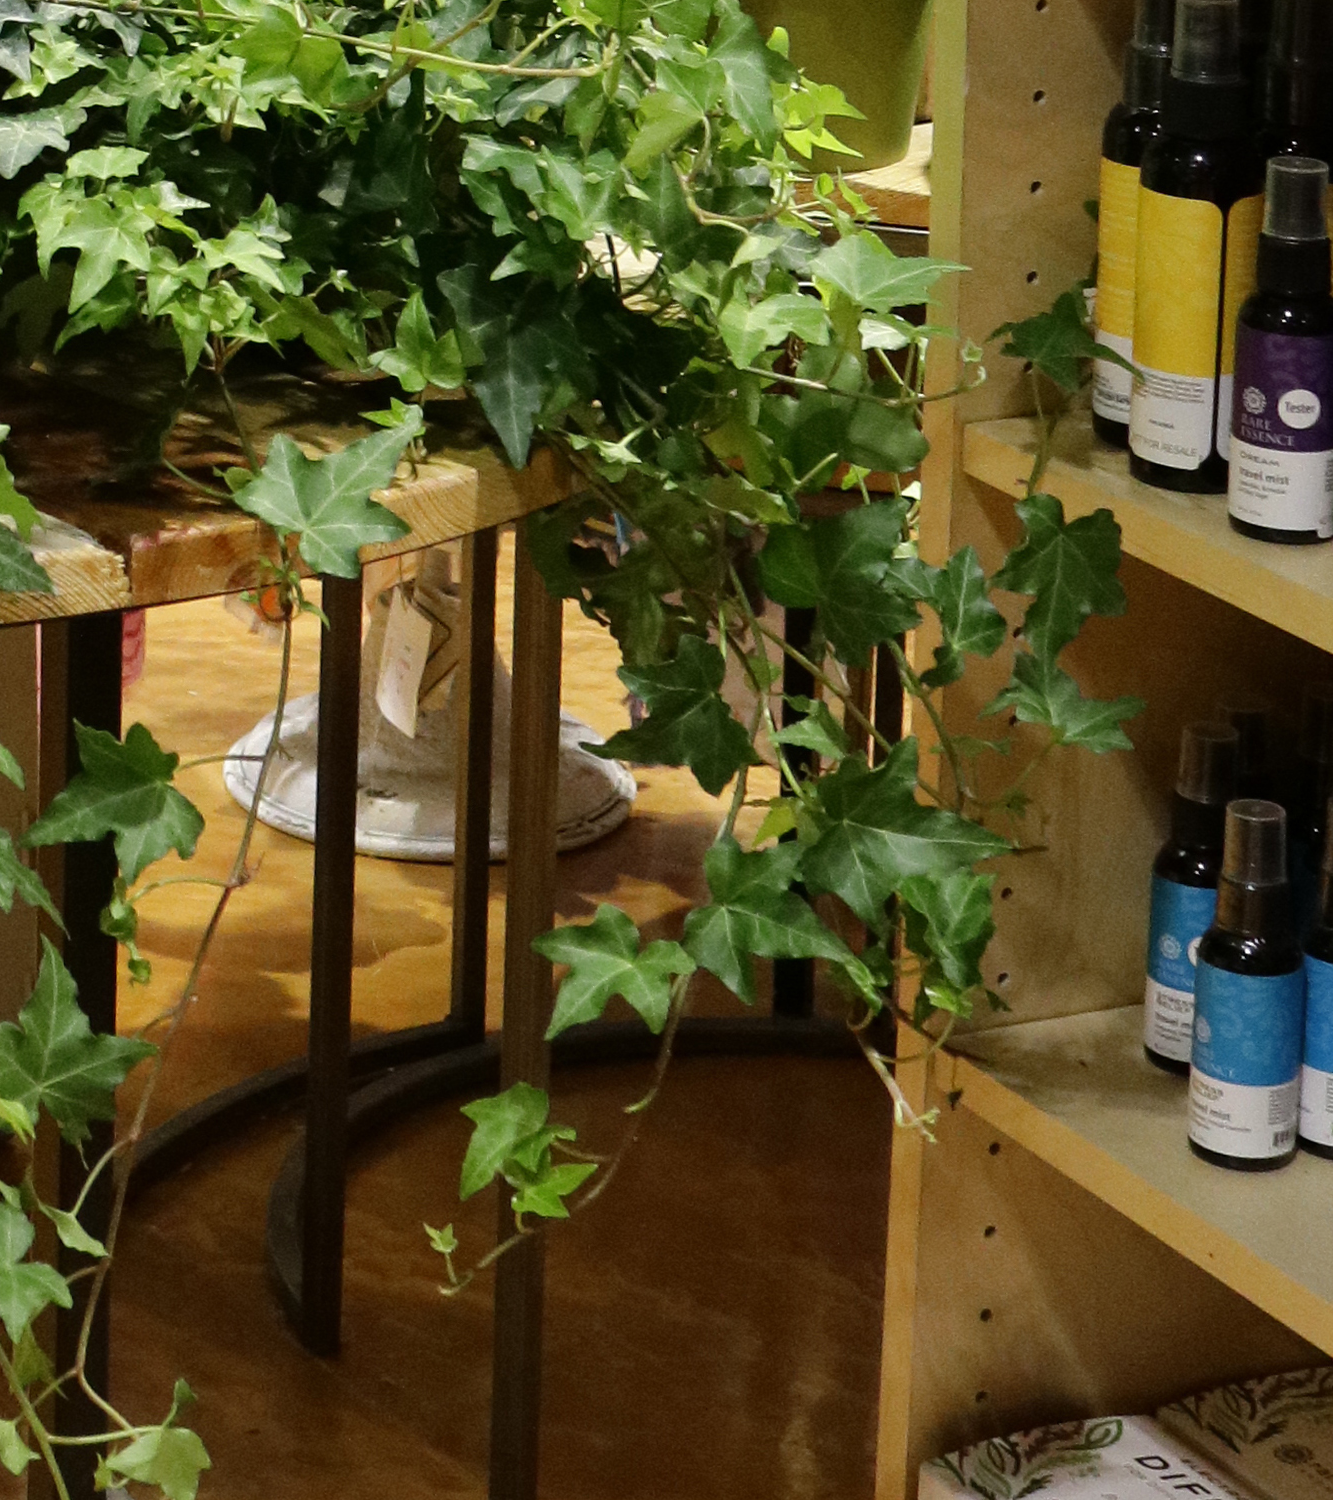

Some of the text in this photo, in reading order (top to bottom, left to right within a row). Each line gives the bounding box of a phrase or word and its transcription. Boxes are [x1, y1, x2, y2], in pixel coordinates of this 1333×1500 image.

[1284, 401, 1316, 414] Tester
[1241, 413, 1271, 431] RARE
[1240, 427, 1295, 447] ESSENCE
[1239, 451, 1280, 467] DREAM
[1265, 473, 1290, 486] mist
